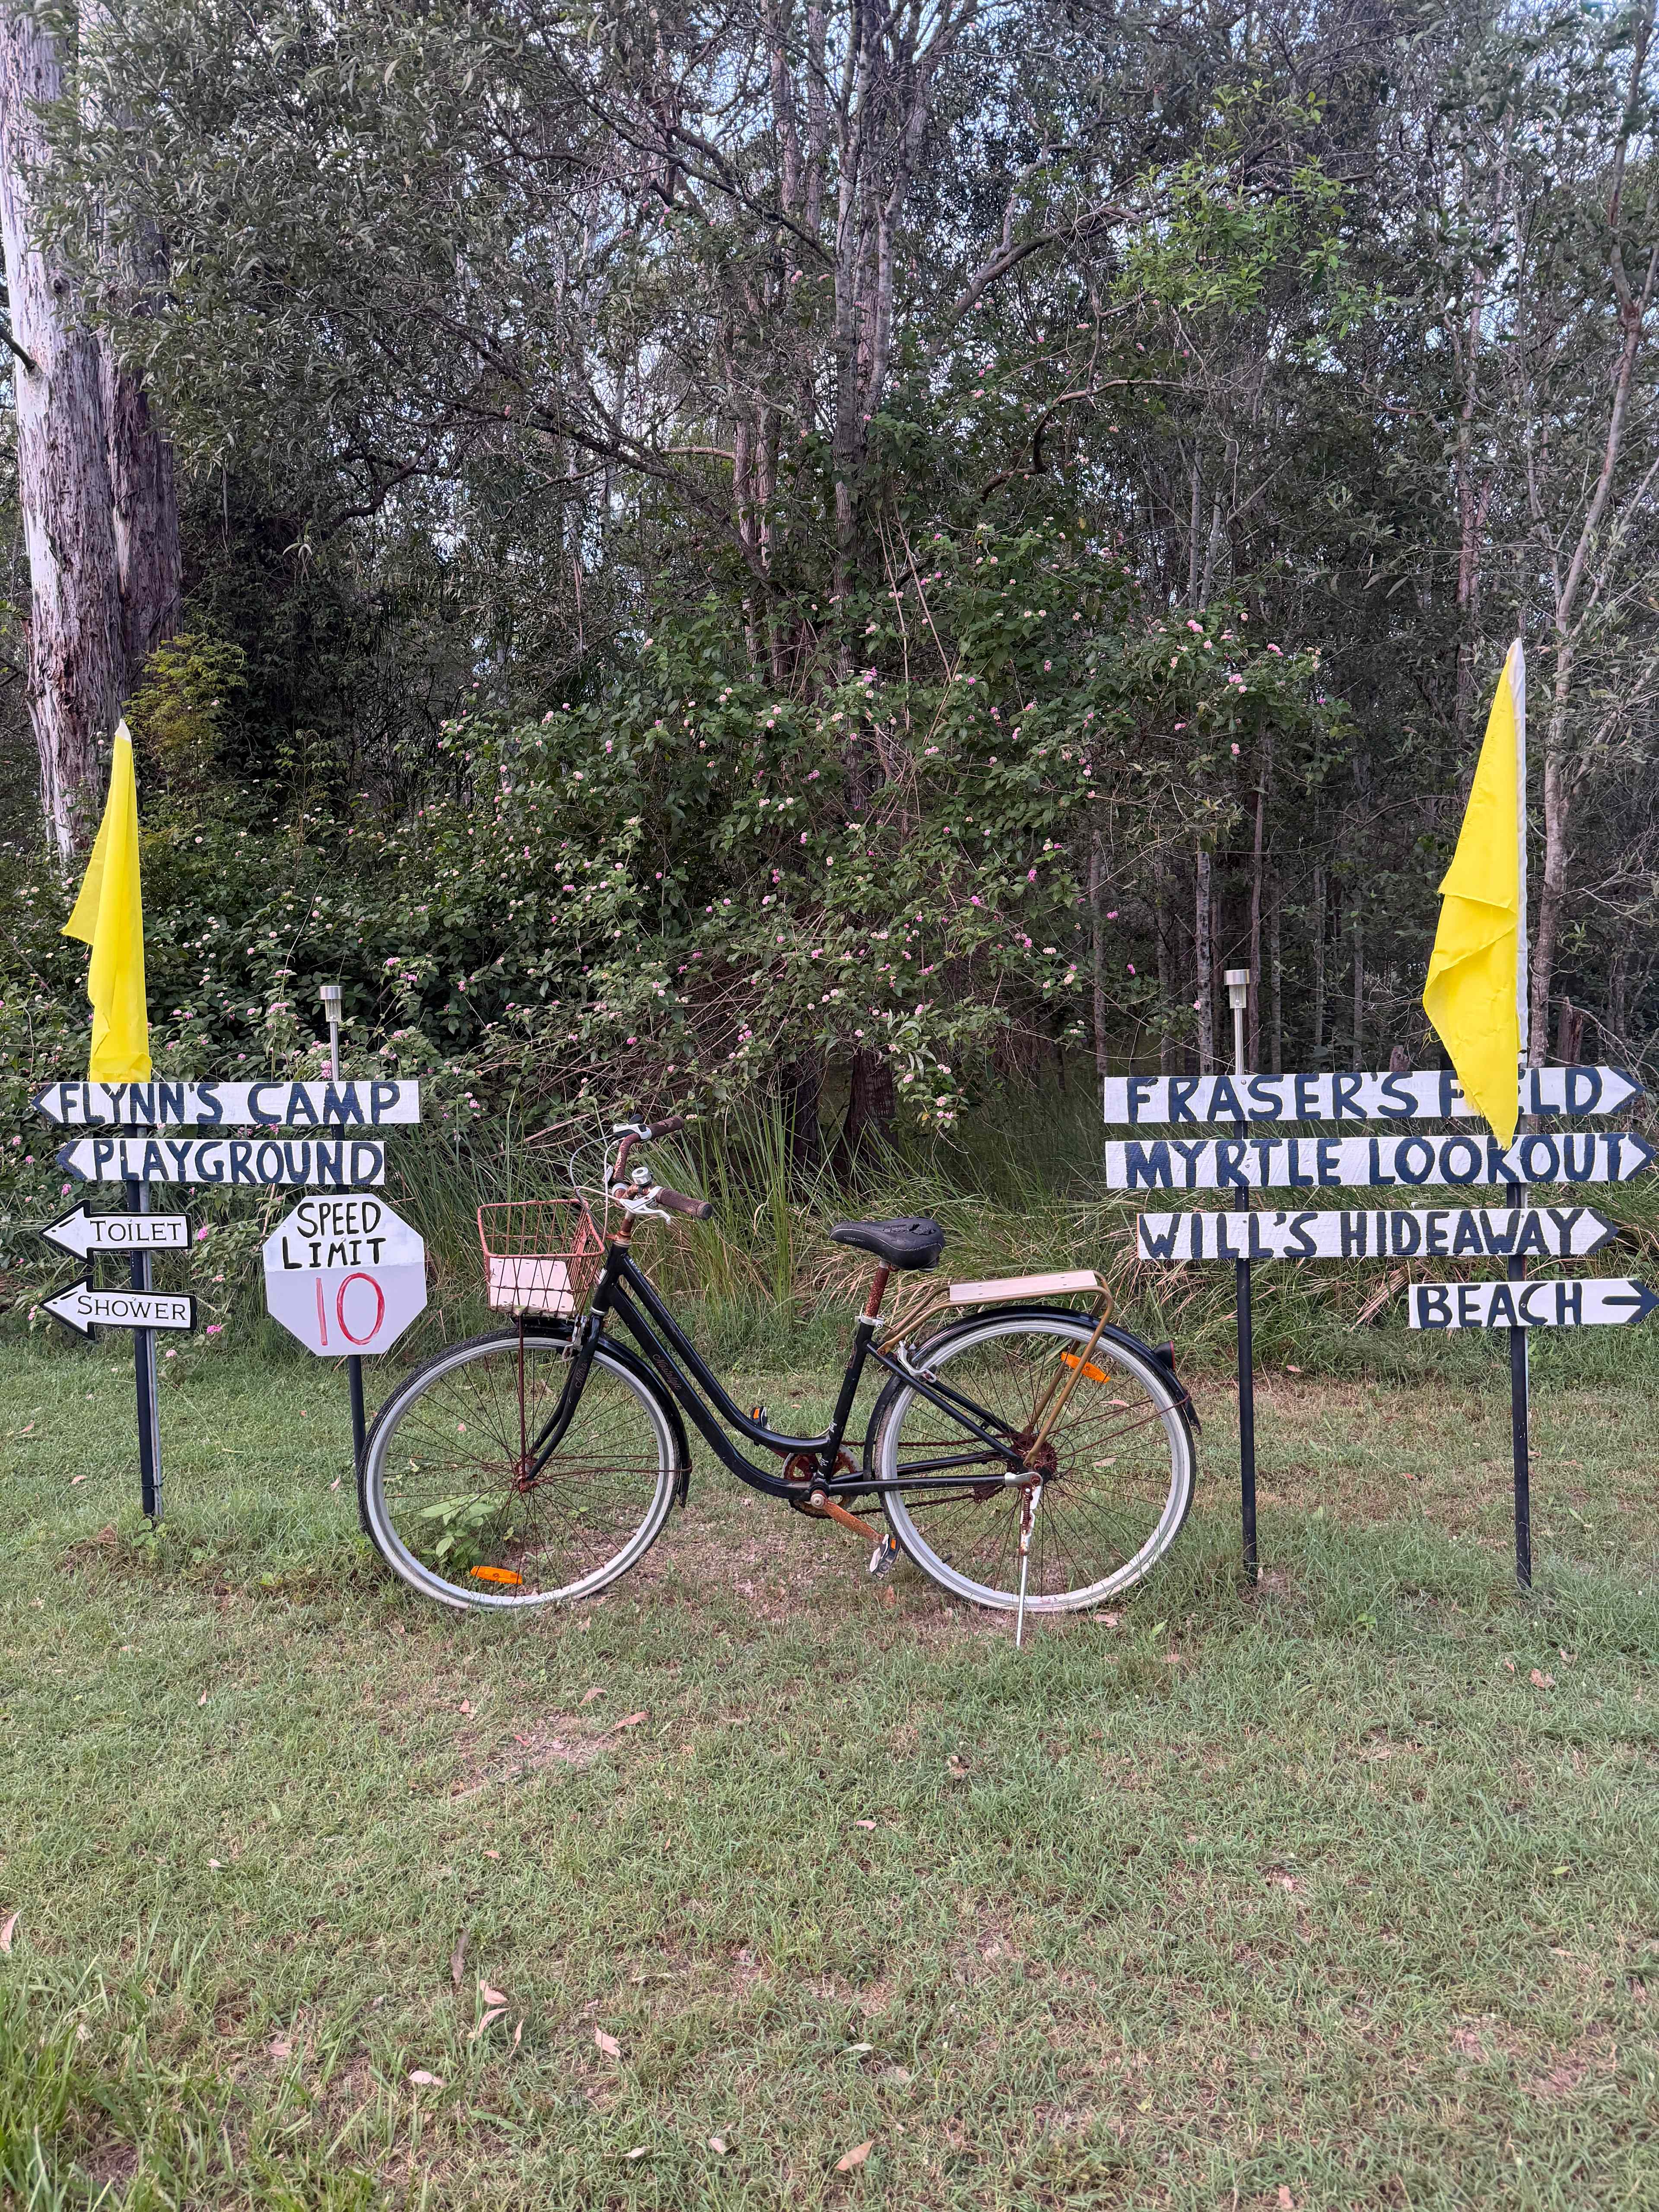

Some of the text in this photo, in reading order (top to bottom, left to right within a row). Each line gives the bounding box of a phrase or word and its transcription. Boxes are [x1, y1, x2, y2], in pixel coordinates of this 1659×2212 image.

[60, 1081, 400, 1123] FLYNN'S CAMP
[1127, 1067, 1602, 1123] FRASER'S FLD
[93, 1140, 385, 1185] PLAYGROUND
[1125, 1133, 1627, 1188] MYRTLE LOOKOUT
[90, 1220, 181, 1242] TOILET
[296, 1202, 381, 1238] SPEED
[1139, 1208, 1585, 1259] WILL'S HIDEAWAY
[282, 1237, 386, 1270] LIMIT
[78, 1296, 187, 1320] SHOWER
[315, 1272, 386, 1346] 10
[1417, 1282, 1582, 1328] BEACH
